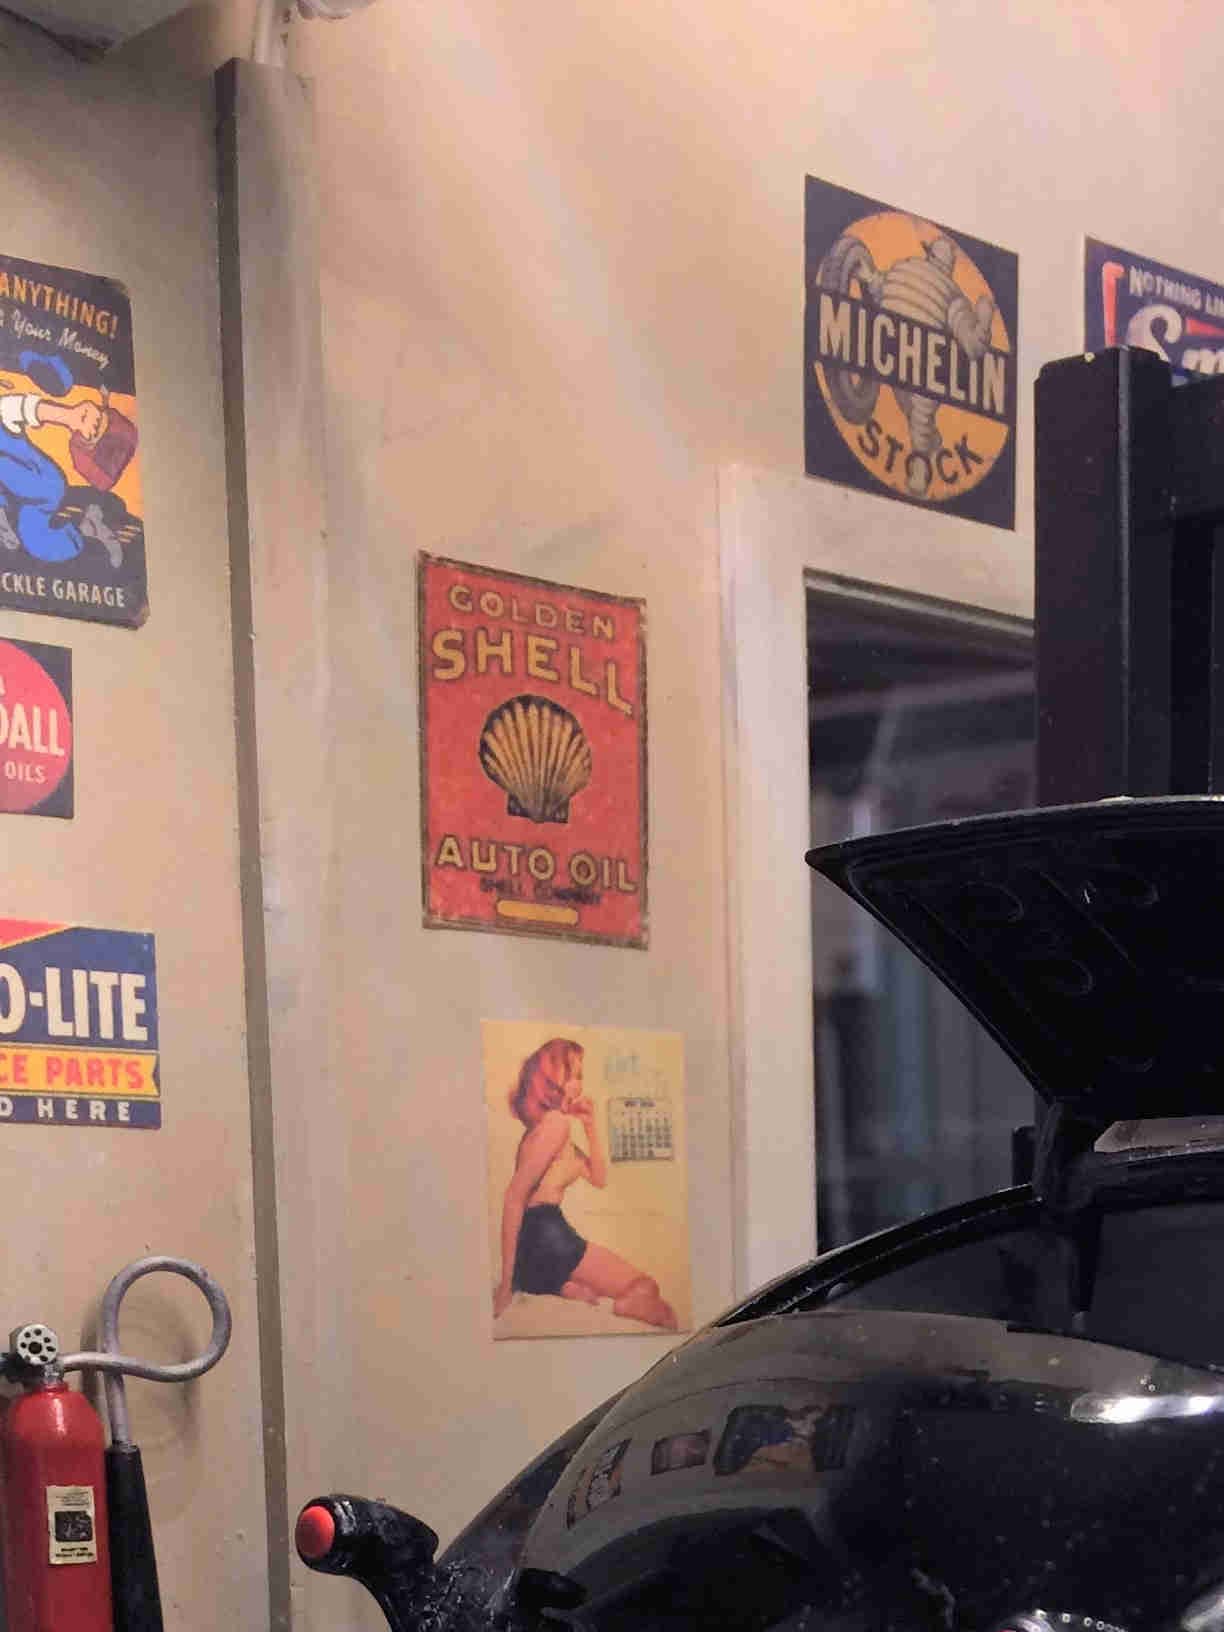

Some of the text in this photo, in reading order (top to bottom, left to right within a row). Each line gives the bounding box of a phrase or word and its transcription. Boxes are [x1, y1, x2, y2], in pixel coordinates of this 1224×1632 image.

[0, 271, 118, 339] ANYTHING!
[11, 309, 51, 341] Your
[58, 327, 109, 371] Money
[819, 293, 1006, 415] MICHELIN
[857, 418, 983, 485] STOCK
[2, 572, 125, 608] CKLE GARAGE
[449, 585, 615, 640] GOLDEN
[431, 629, 634, 717] SHELL
[4, 760, 46, 784] OILS
[435, 834, 637, 892] AUTO OIL
[45, 1055, 145, 1090] PARTS
[37, 1097, 131, 1122] HERE
